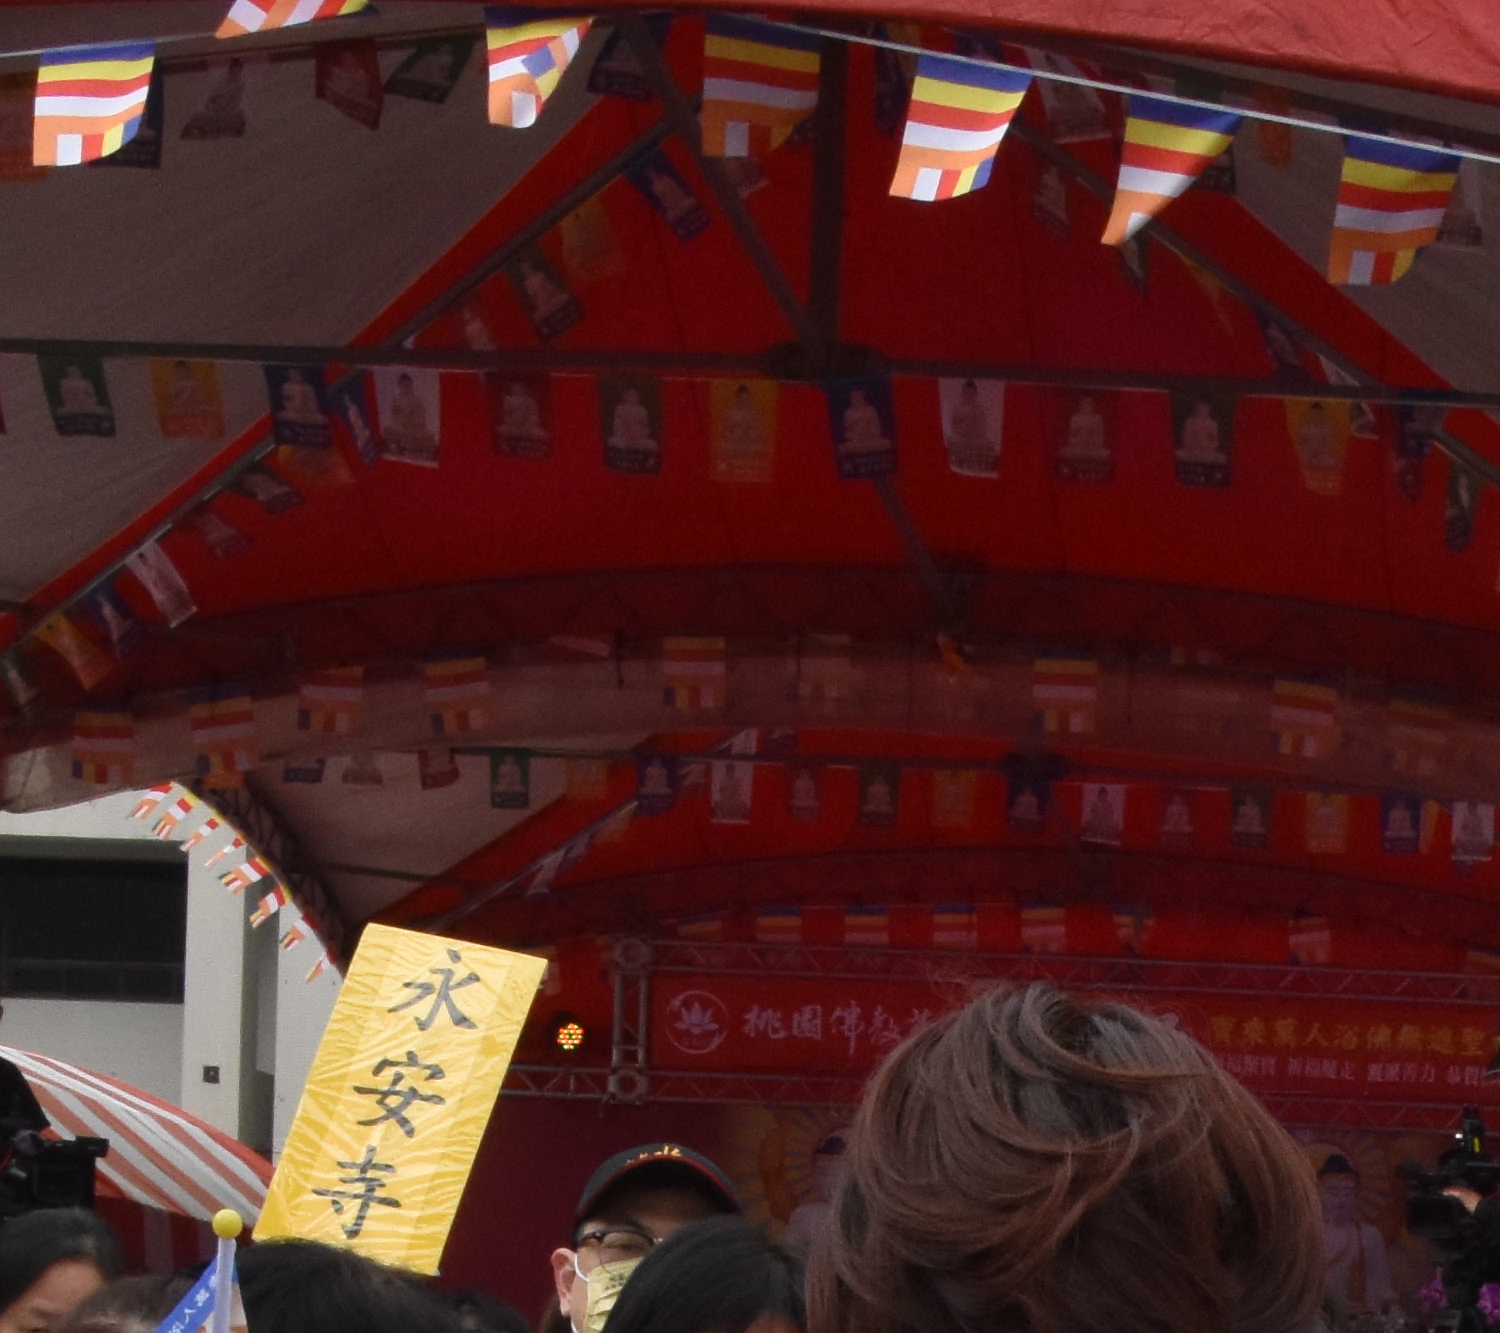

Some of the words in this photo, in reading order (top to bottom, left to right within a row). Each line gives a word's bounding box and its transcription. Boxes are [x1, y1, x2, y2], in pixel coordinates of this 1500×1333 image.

[313, 948, 479, 1240] 永安寺
[743, 1003, 931, 1053] 桃園佛教
